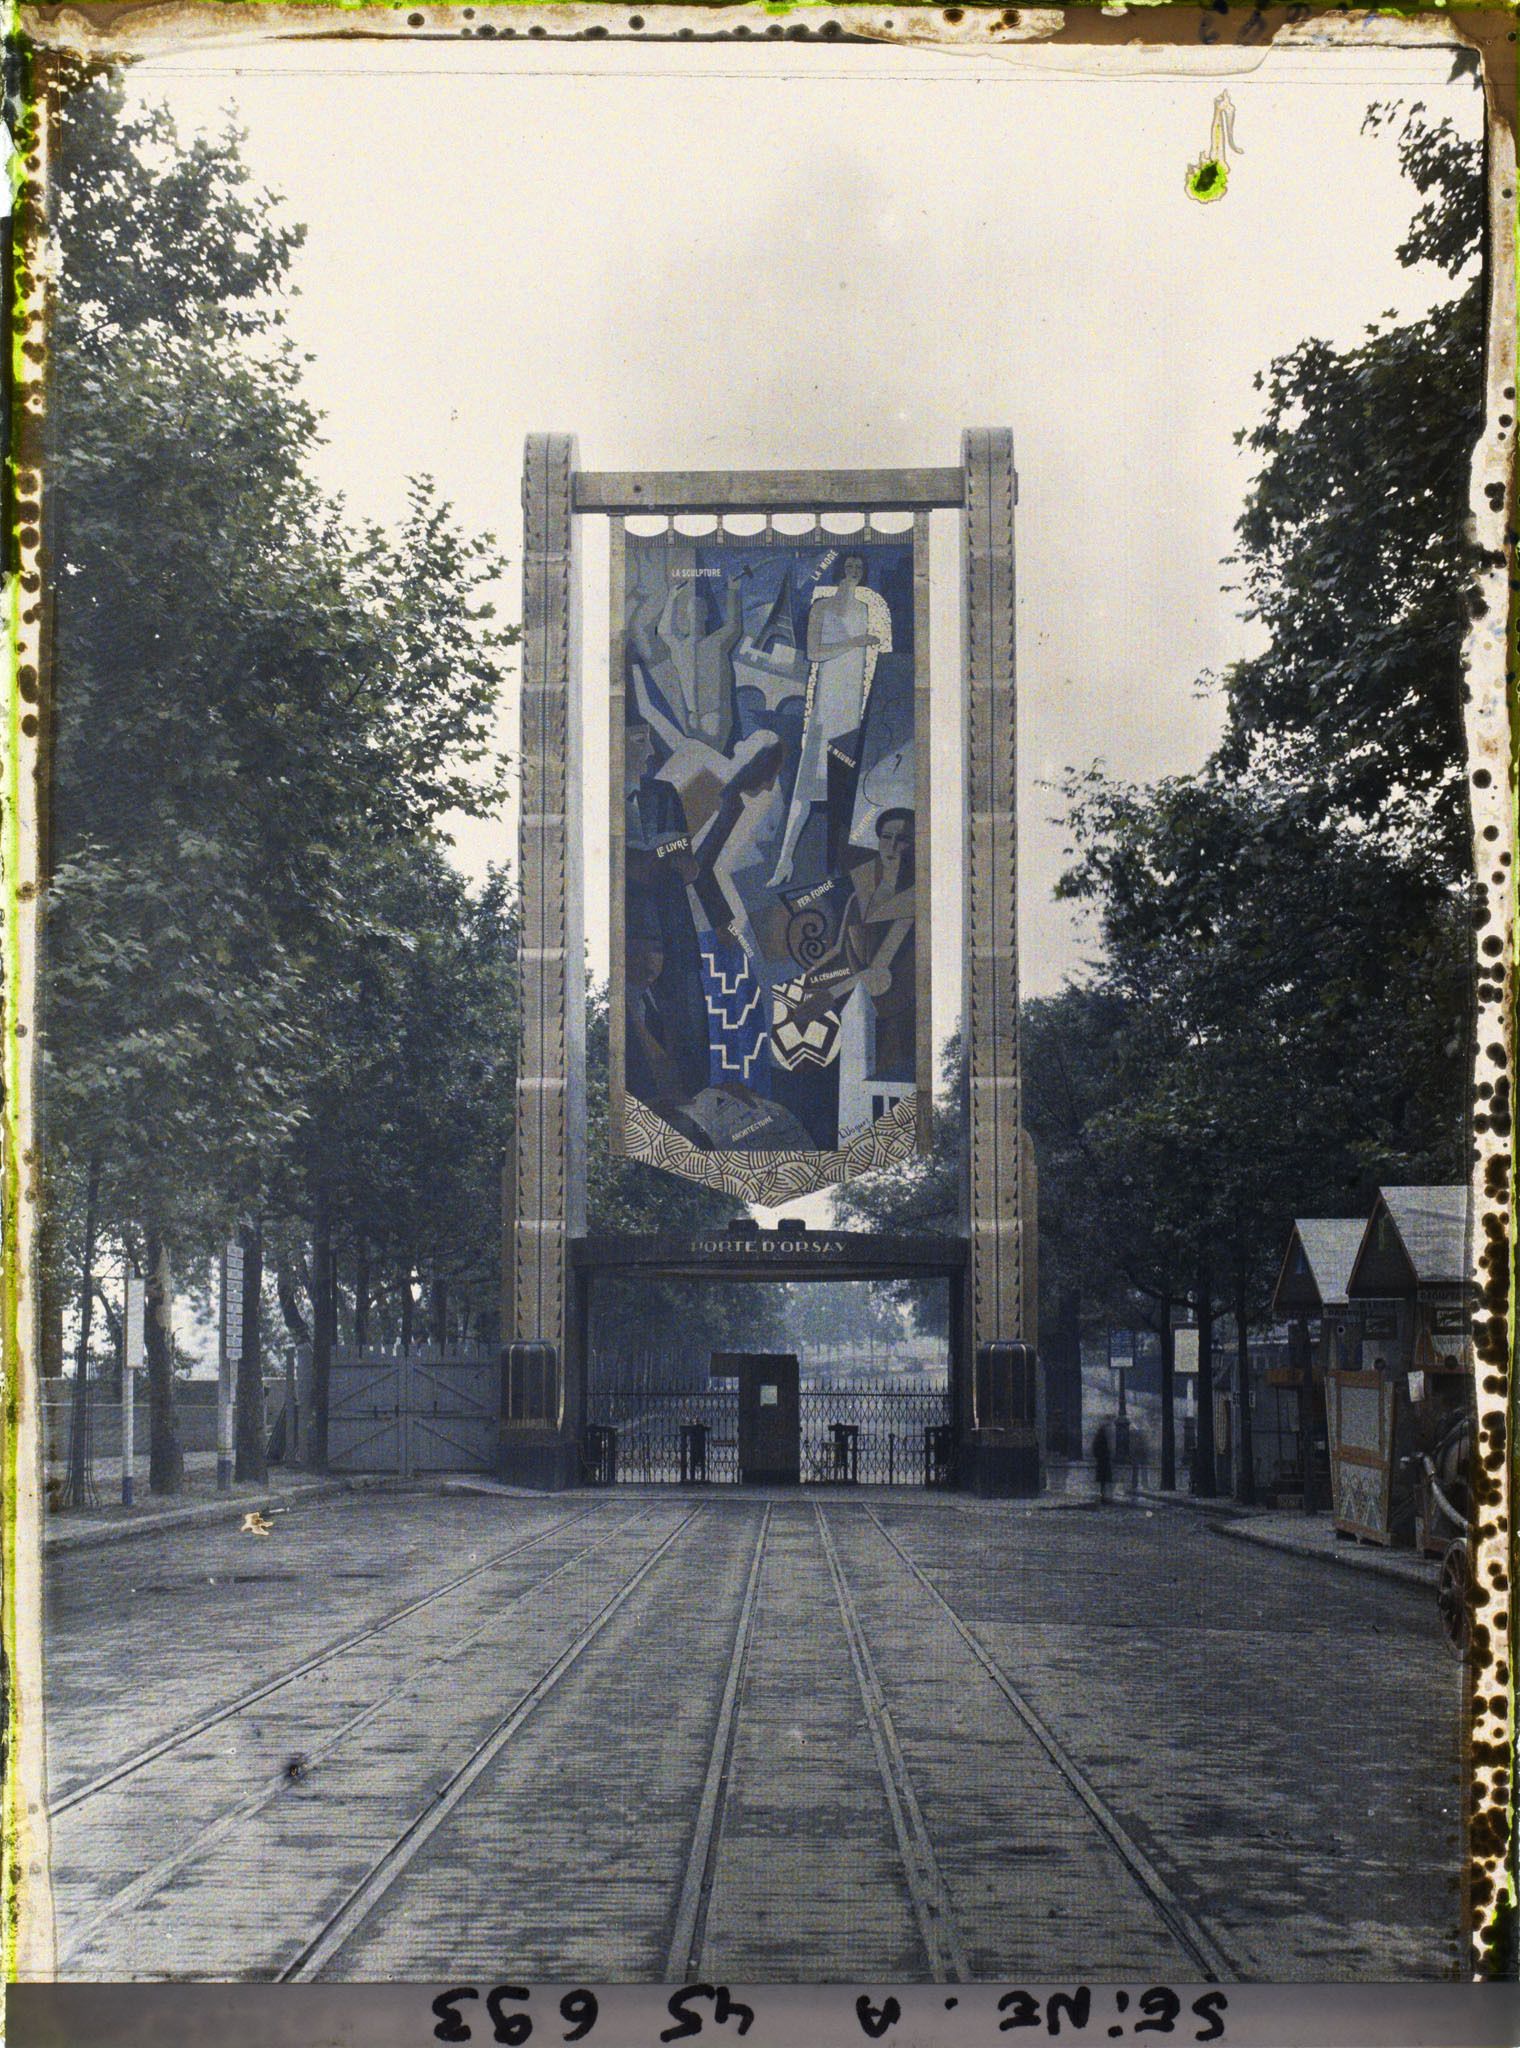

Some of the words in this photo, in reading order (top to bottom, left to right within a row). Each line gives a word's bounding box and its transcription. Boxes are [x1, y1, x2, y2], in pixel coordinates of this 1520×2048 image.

[820, 549, 839, 570] MODE
[671, 568, 681, 578] LA
[682, 568, 722, 578] SCULPTURE
[656, 846, 666, 858] LE
[665, 837, 689, 853] LIVRE
[810, 975, 819, 984] LA
[691, 1241, 757, 1252] PORTE
[762, 1241, 848, 1253] D'ORSAY
[660, 1984, 755, 2043] 45
[855, 1994, 901, 2039] A
